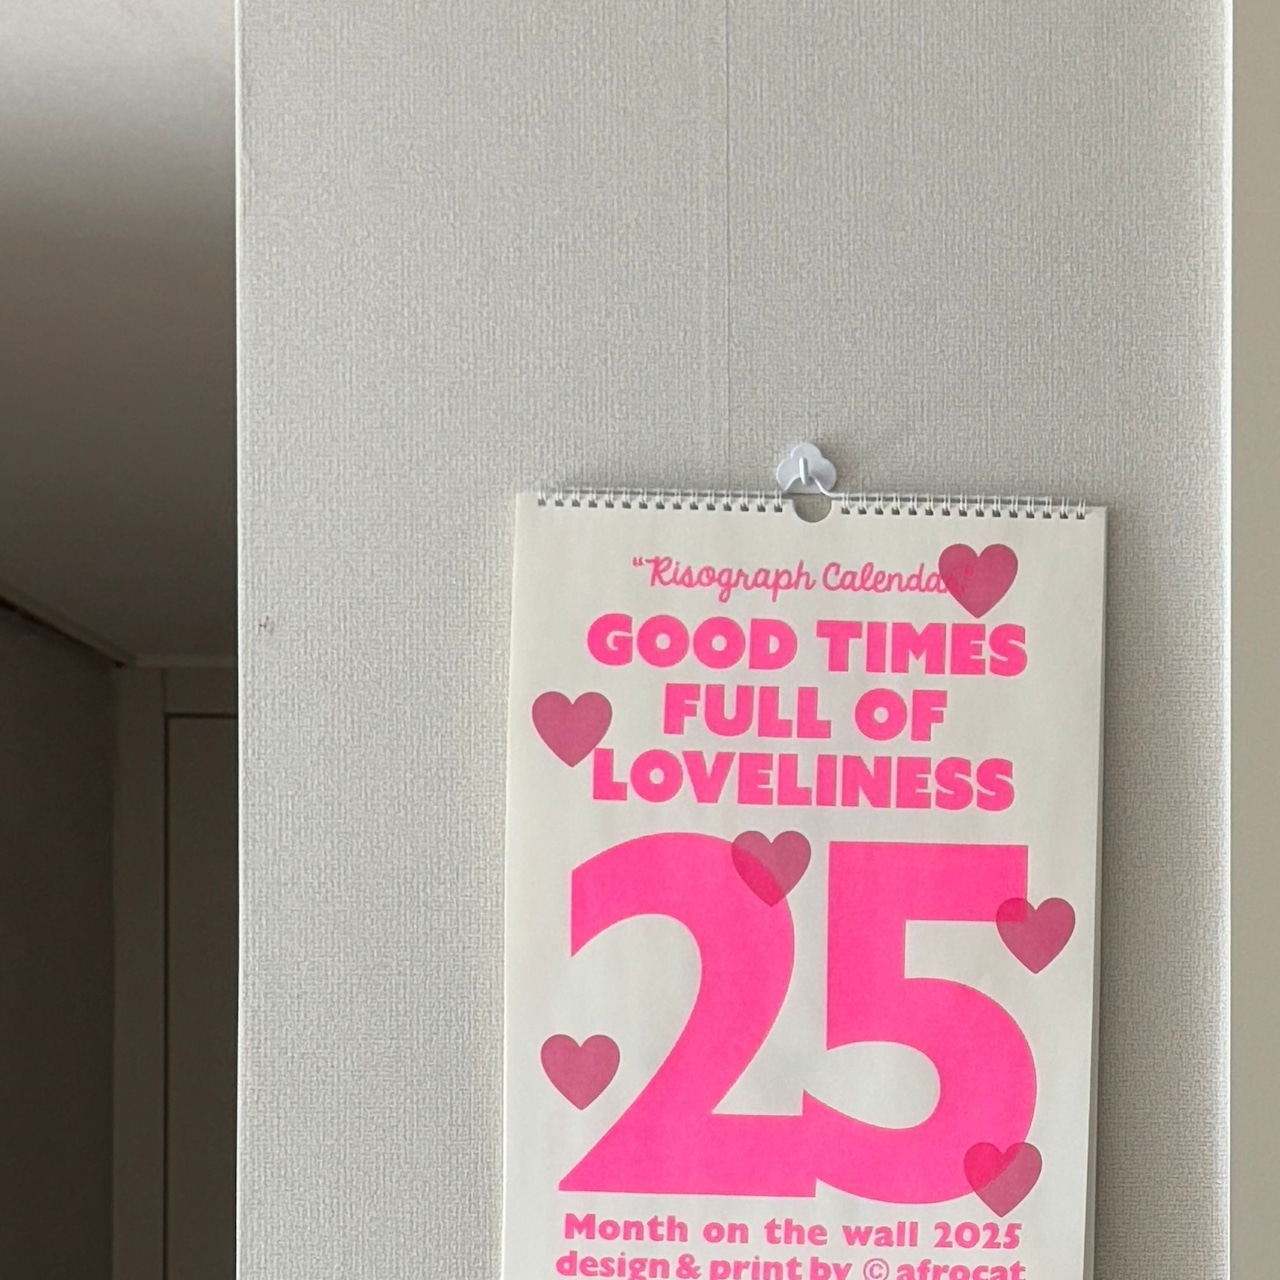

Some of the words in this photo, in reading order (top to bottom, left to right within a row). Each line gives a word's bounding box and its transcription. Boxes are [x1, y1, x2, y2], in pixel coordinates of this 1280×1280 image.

[586, 613, 797, 671] GOOD
[815, 620, 1027, 678] TIMES
[662, 683, 831, 740] FULL
[853, 688, 947, 742] OF
[592, 747, 1014, 813] LOVELINESS
[558, 832, 1037, 1204] 25
[564, 1214, 687, 1242] Month
[702, 1223, 748, 1244] on
[765, 1219, 826, 1246] the
[842, 1222, 918, 1247] wall
[935, 1221, 1020, 1250] 2025
